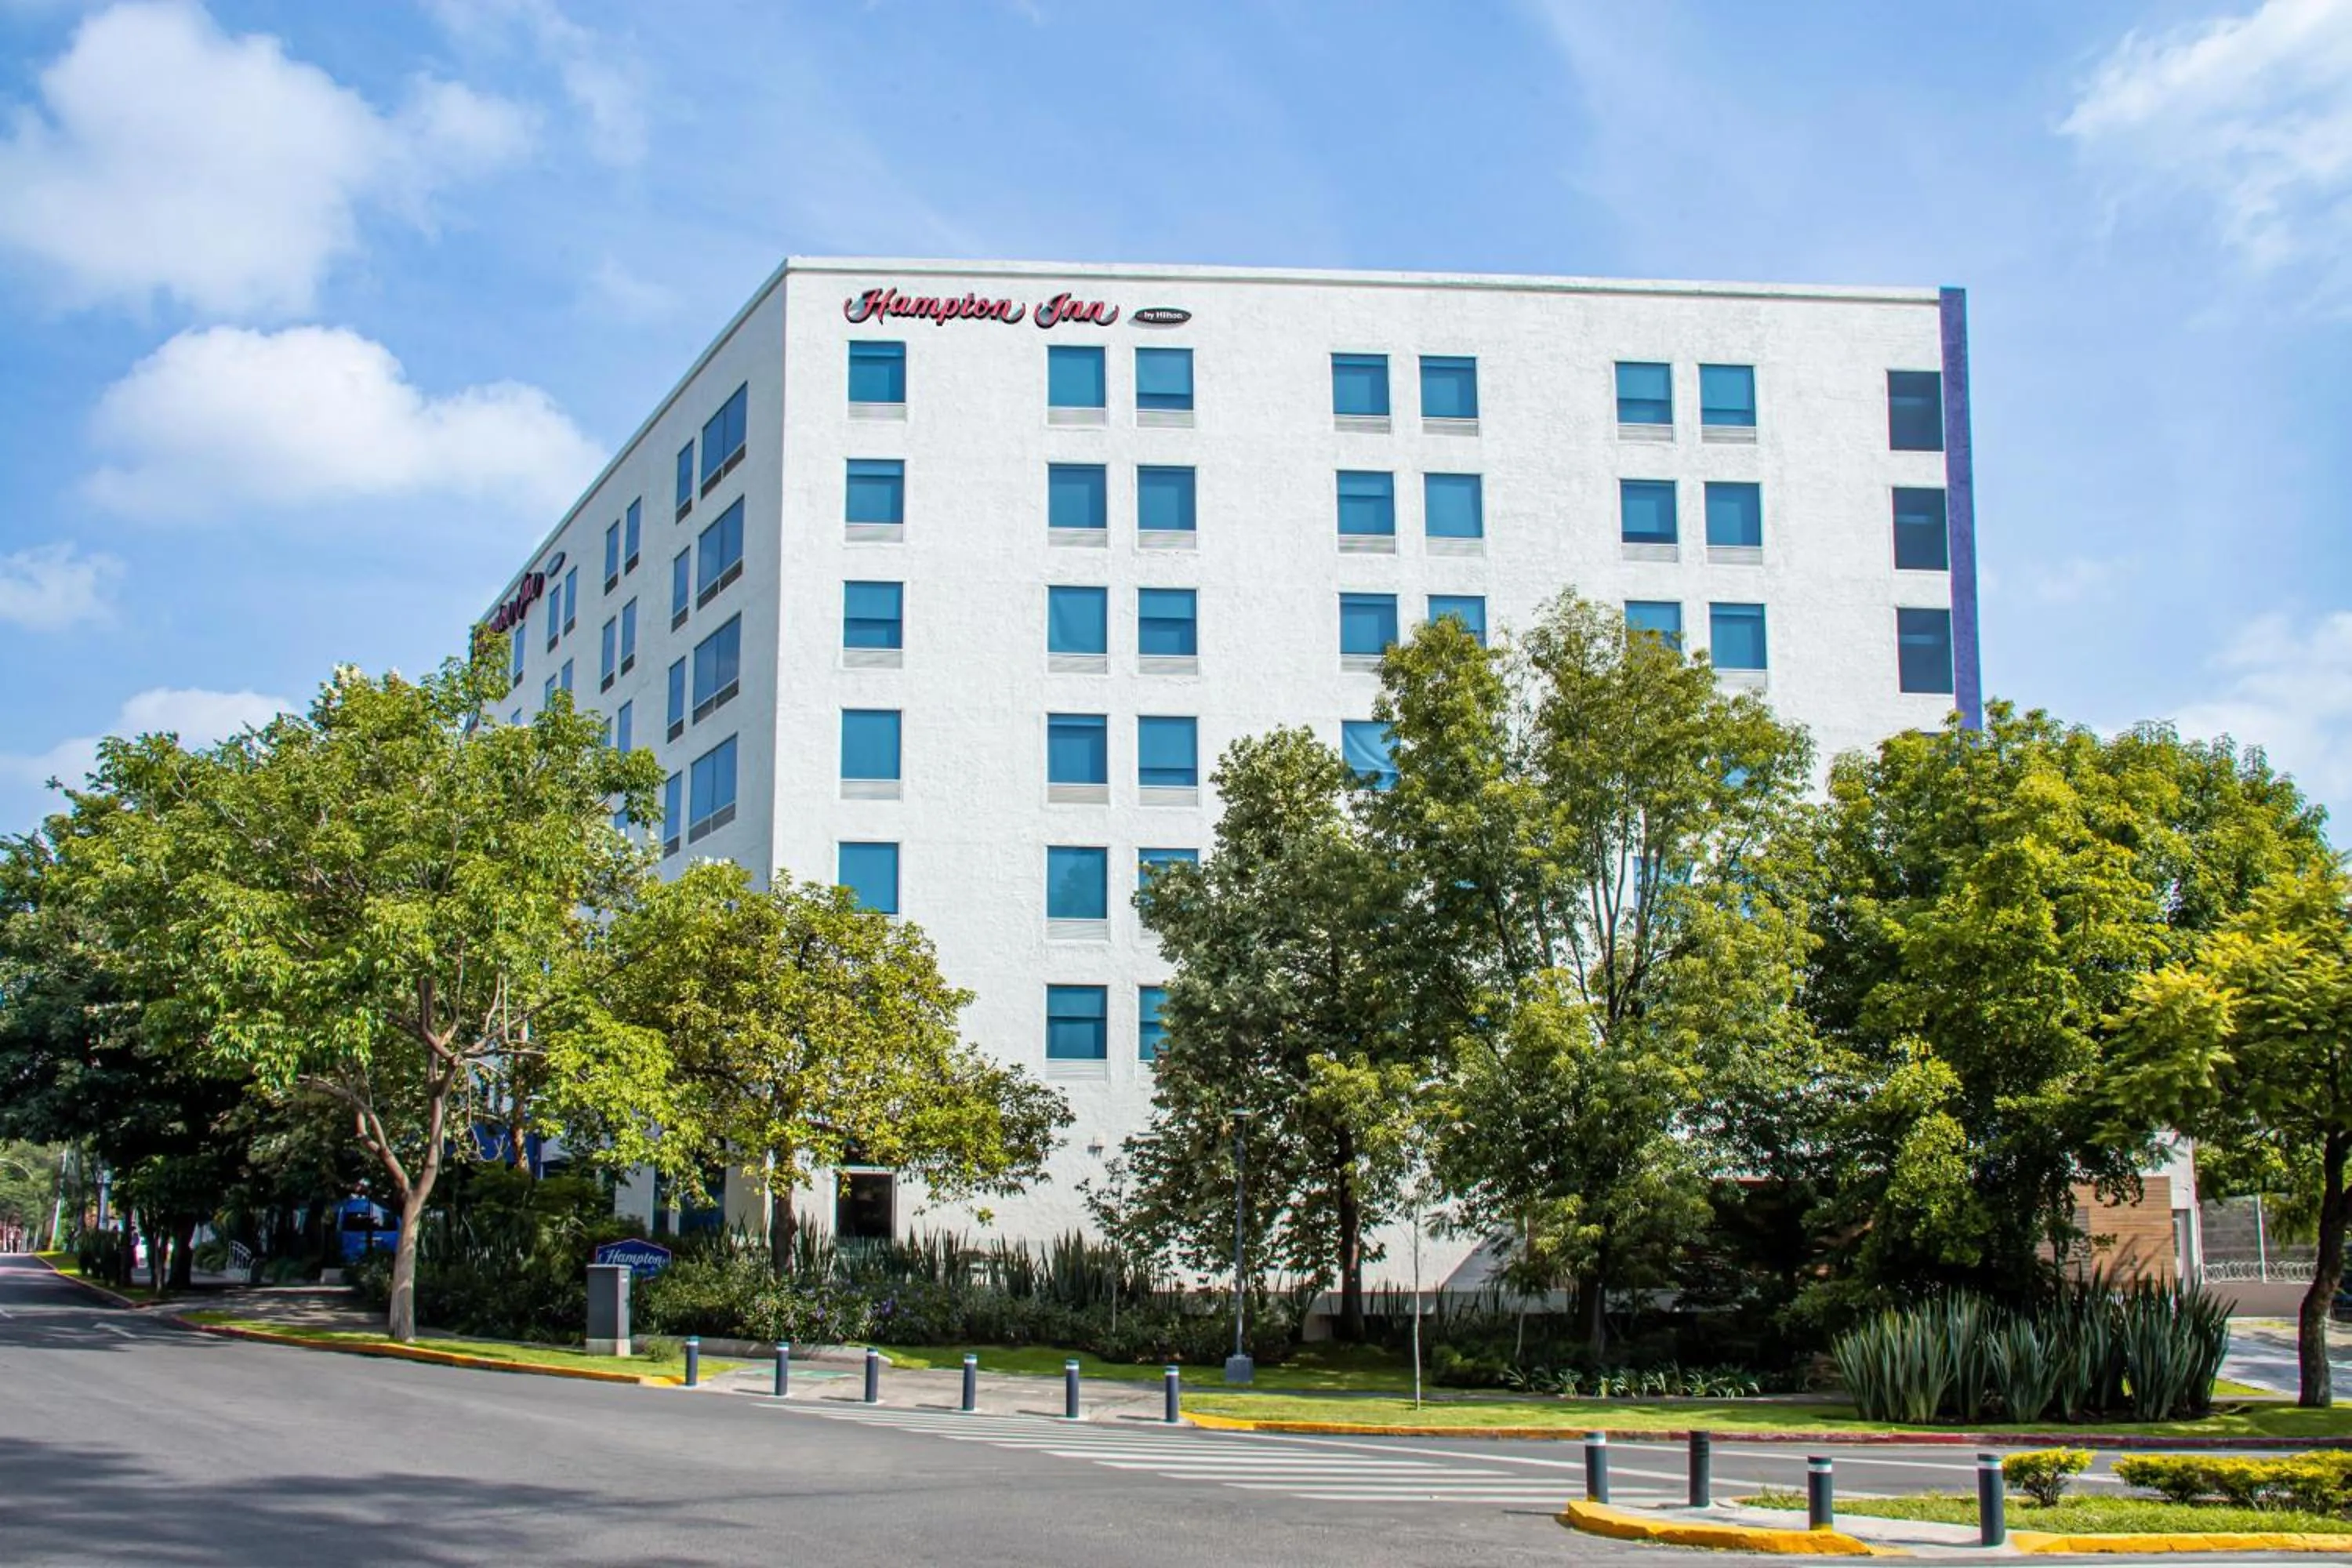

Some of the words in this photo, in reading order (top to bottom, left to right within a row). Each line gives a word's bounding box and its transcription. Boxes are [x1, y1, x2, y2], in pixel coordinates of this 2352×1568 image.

[844, 287, 1025, 326] Hampton
[1034, 292, 1120, 328] Inn
[598, 1248, 669, 1267] Hampton
